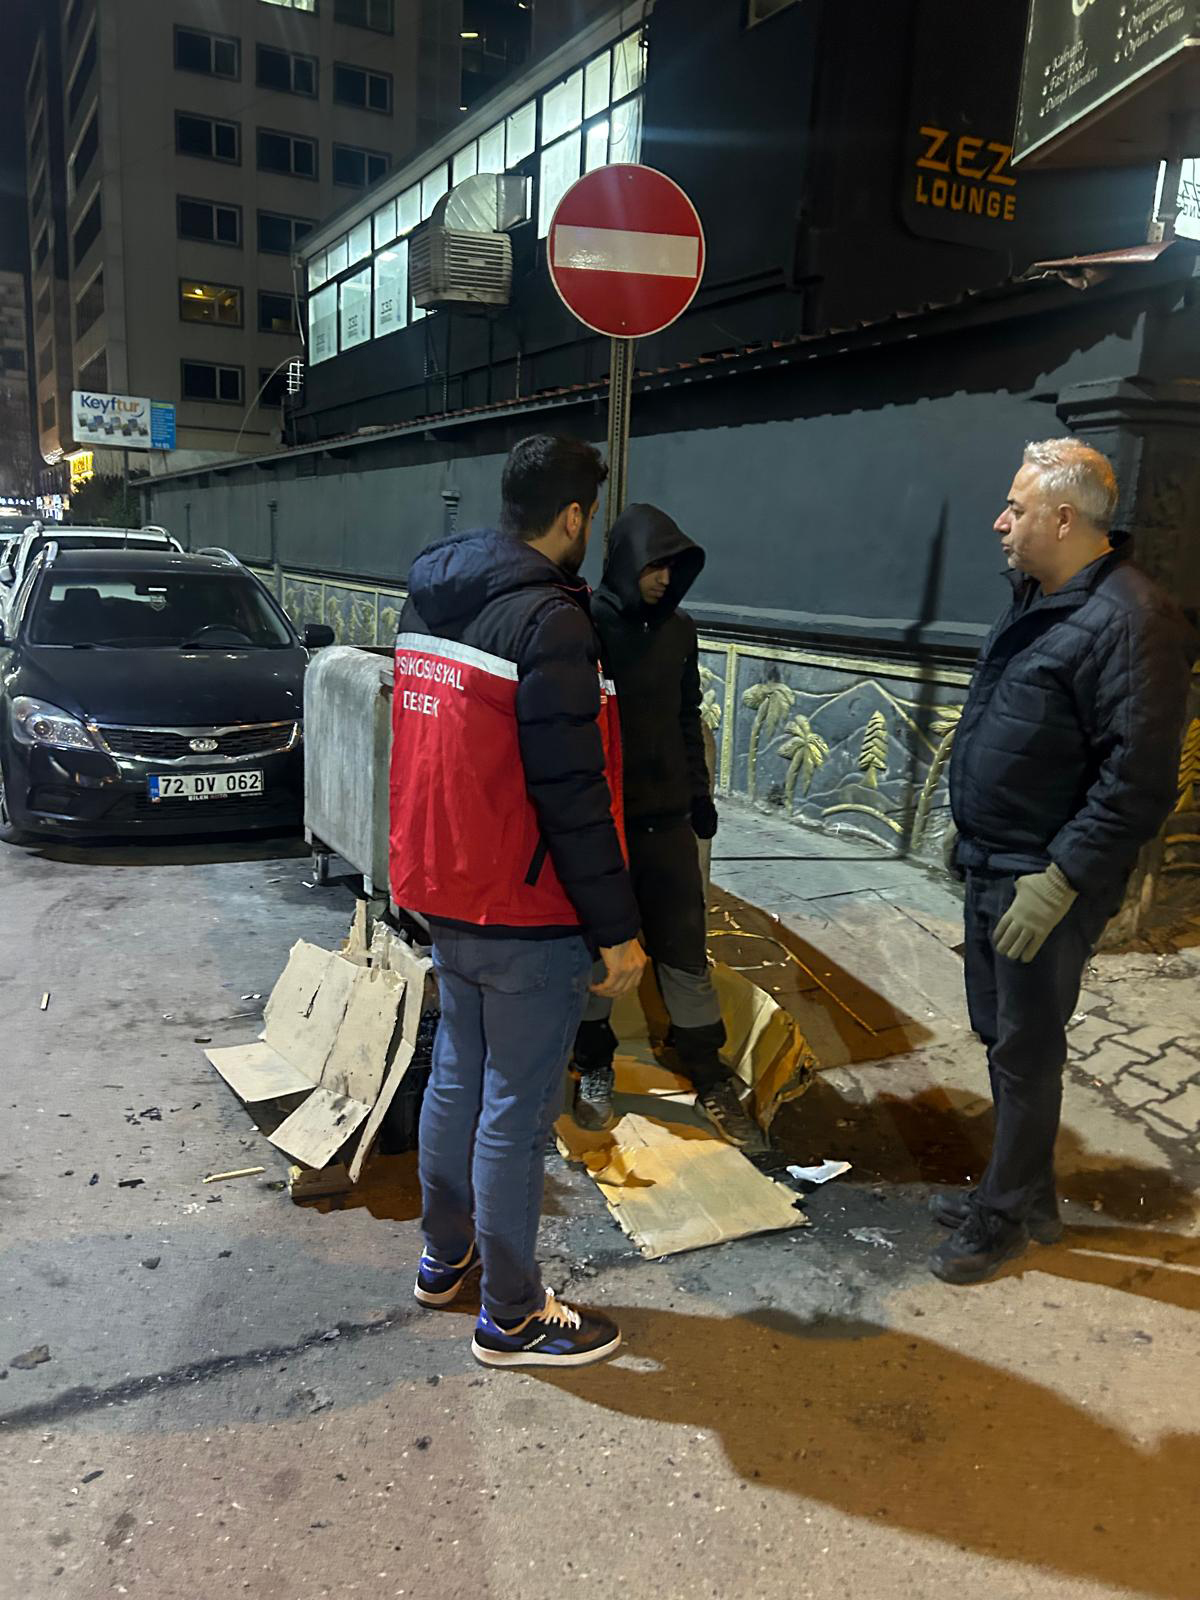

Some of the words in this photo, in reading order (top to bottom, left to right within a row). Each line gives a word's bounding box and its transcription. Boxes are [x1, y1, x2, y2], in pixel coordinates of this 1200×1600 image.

[916, 126, 1017, 186] ZEZ
[916, 175, 1017, 221] LOUNGE
[81, 394, 140, 414] Keyftur
[161, 779, 185, 795] 72
[194, 777, 216, 793] DV
[226, 774, 260, 791] 062
